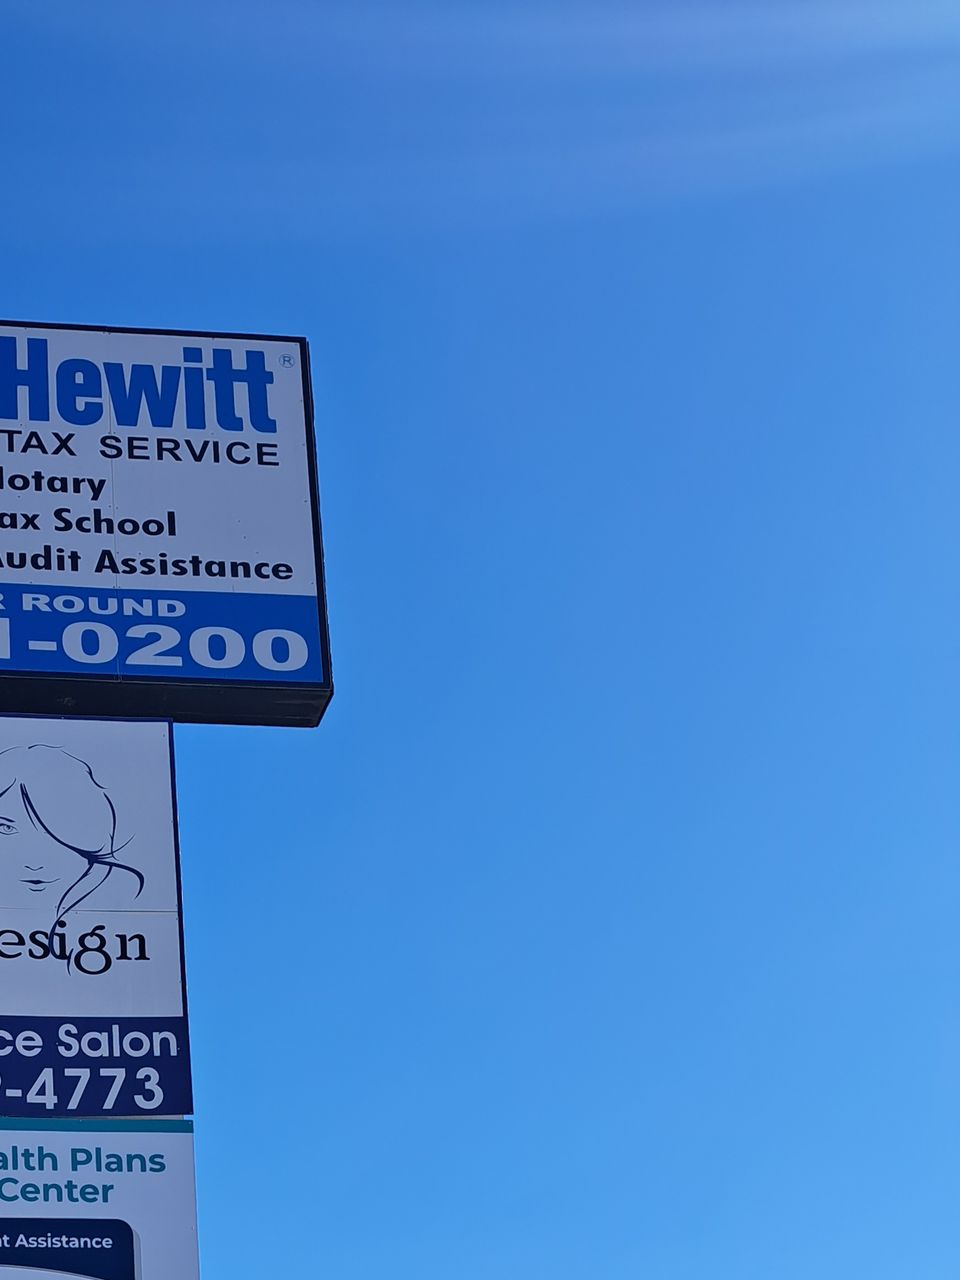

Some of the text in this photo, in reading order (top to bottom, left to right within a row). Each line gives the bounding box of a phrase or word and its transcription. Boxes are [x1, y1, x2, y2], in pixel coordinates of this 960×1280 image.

[0, 429, 281, 467] TAX SERVICE
[52, 507, 177, 538] School
[94, 549, 294, 581] Assistance
[21, 592, 187, 619] ROUND
[57, 1024, 178, 1058] Salon
[70, 1147, 166, 1174] Plans
[15, 1233, 113, 1249] Assistance
